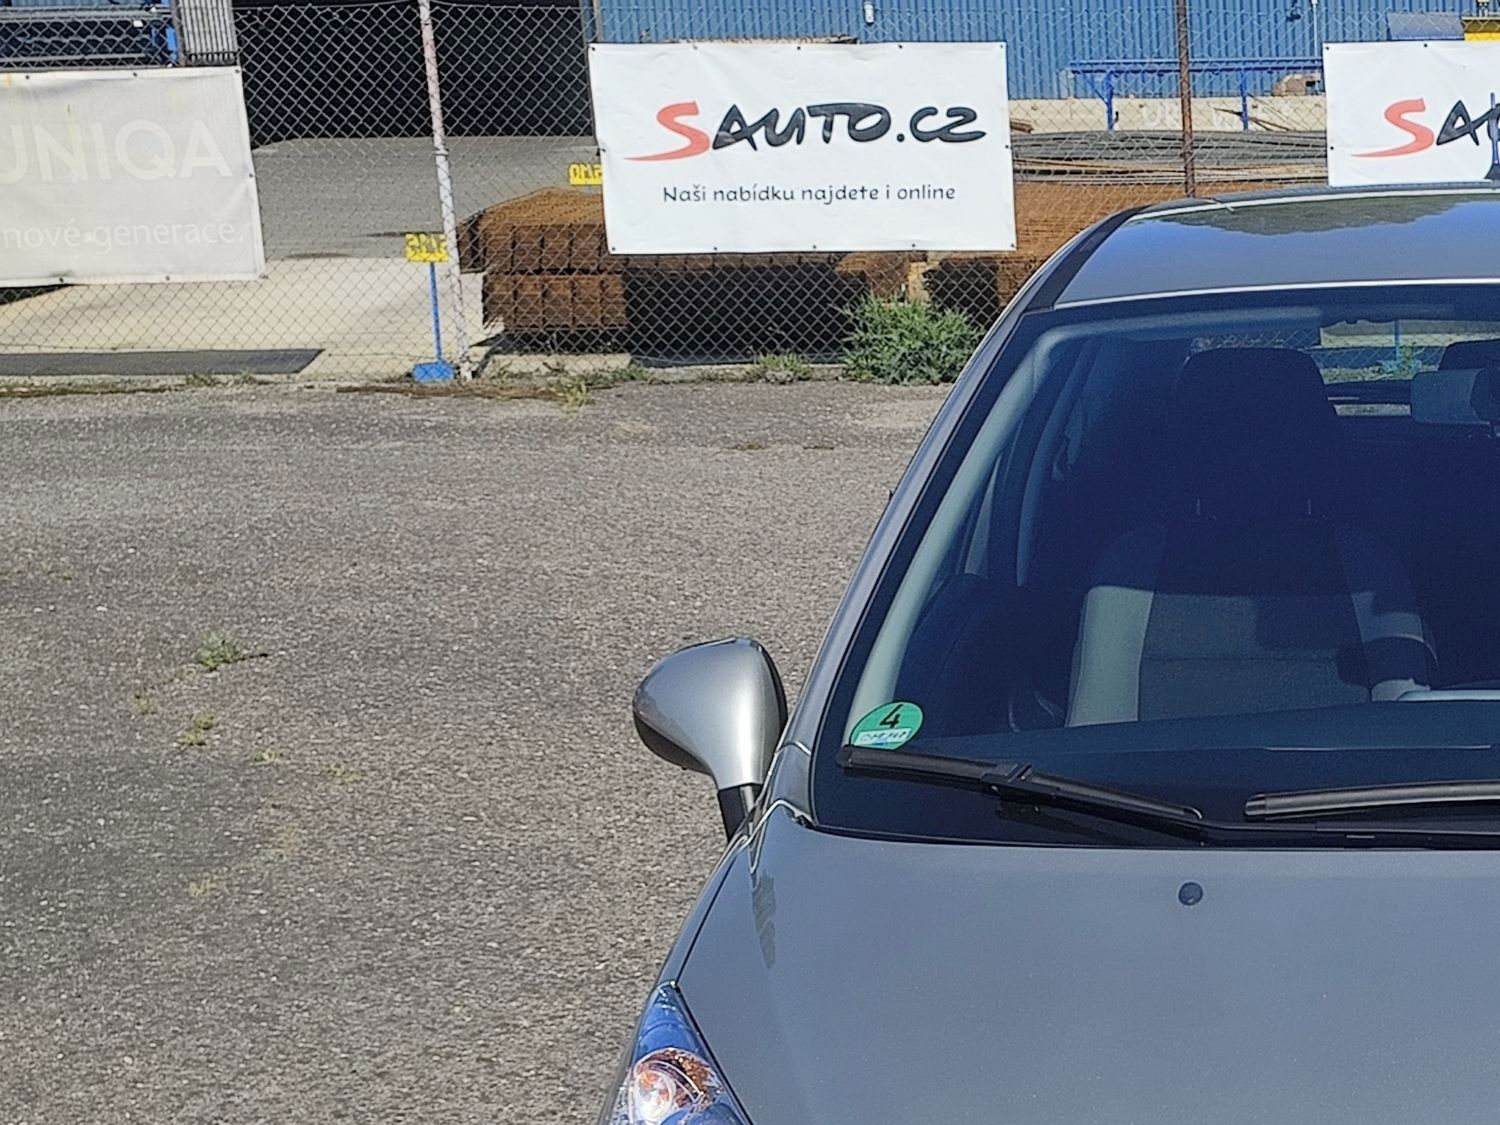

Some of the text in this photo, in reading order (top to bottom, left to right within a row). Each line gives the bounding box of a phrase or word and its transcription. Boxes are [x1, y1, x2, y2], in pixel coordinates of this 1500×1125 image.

[663, 184, 956, 205] Naši nabídku najdete i online
[3, 218, 244, 254] nové generace.
[880, 704, 903, 728] 4
